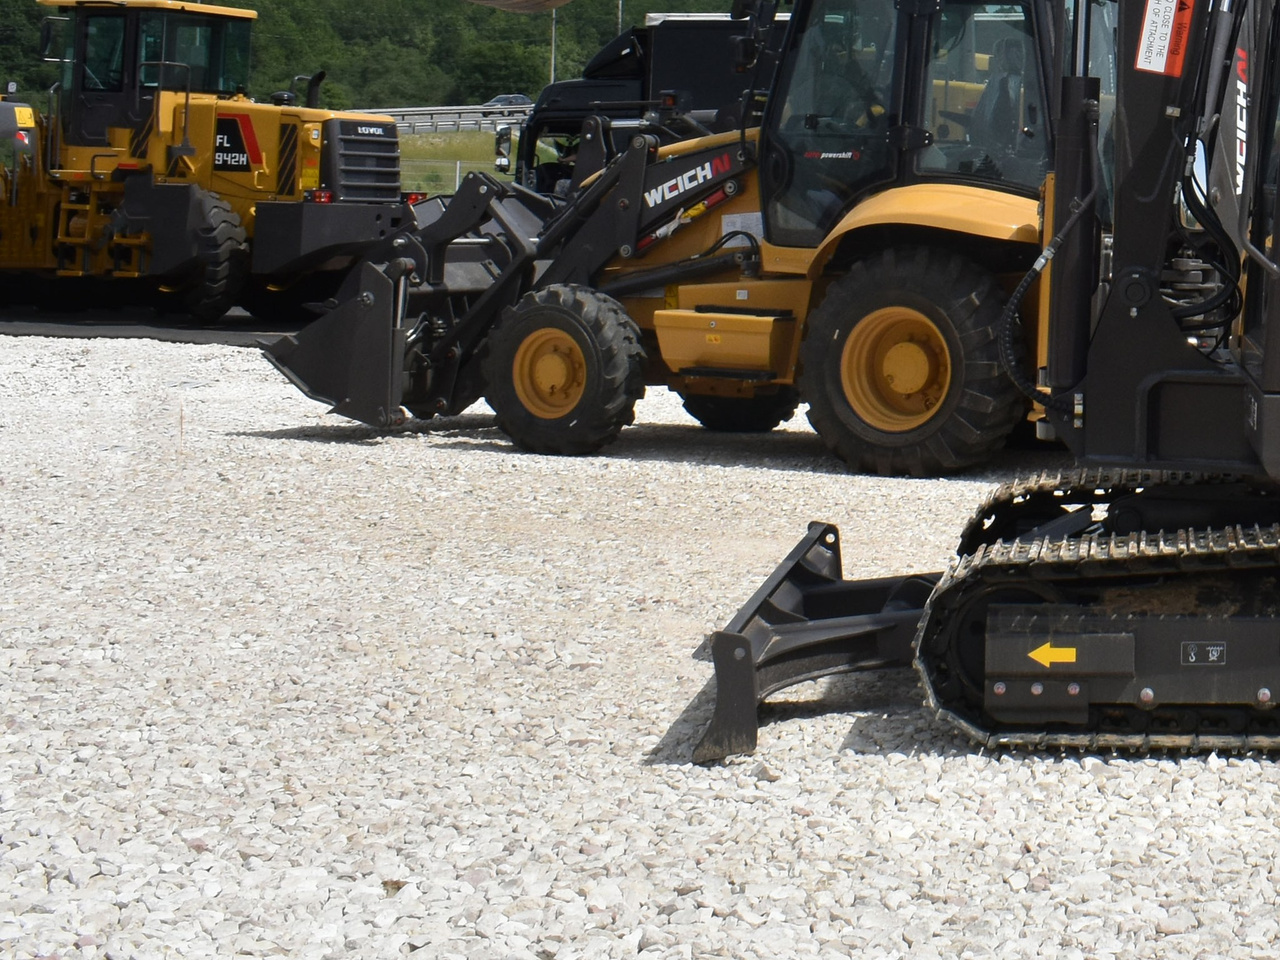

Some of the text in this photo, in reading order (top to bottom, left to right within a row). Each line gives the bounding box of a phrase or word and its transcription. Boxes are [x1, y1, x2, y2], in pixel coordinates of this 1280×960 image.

[1152, 8, 1161, 18] OF
[1161, 6, 1172, 29] CLOSE
[1143, 20, 1158, 65] ATTACHMENT
[1159, 32, 1168, 42] TO
[1171, 22, 1187, 56] Warning
[1156, 44, 1166, 58] THE
[1236, 47, 1248, 195] WEICHAI
[357, 126, 384, 135] LOVOL
[216, 134, 231, 147] FL
[214, 152, 248, 166] 942H
[644, 152, 732, 208] WEICHAI
